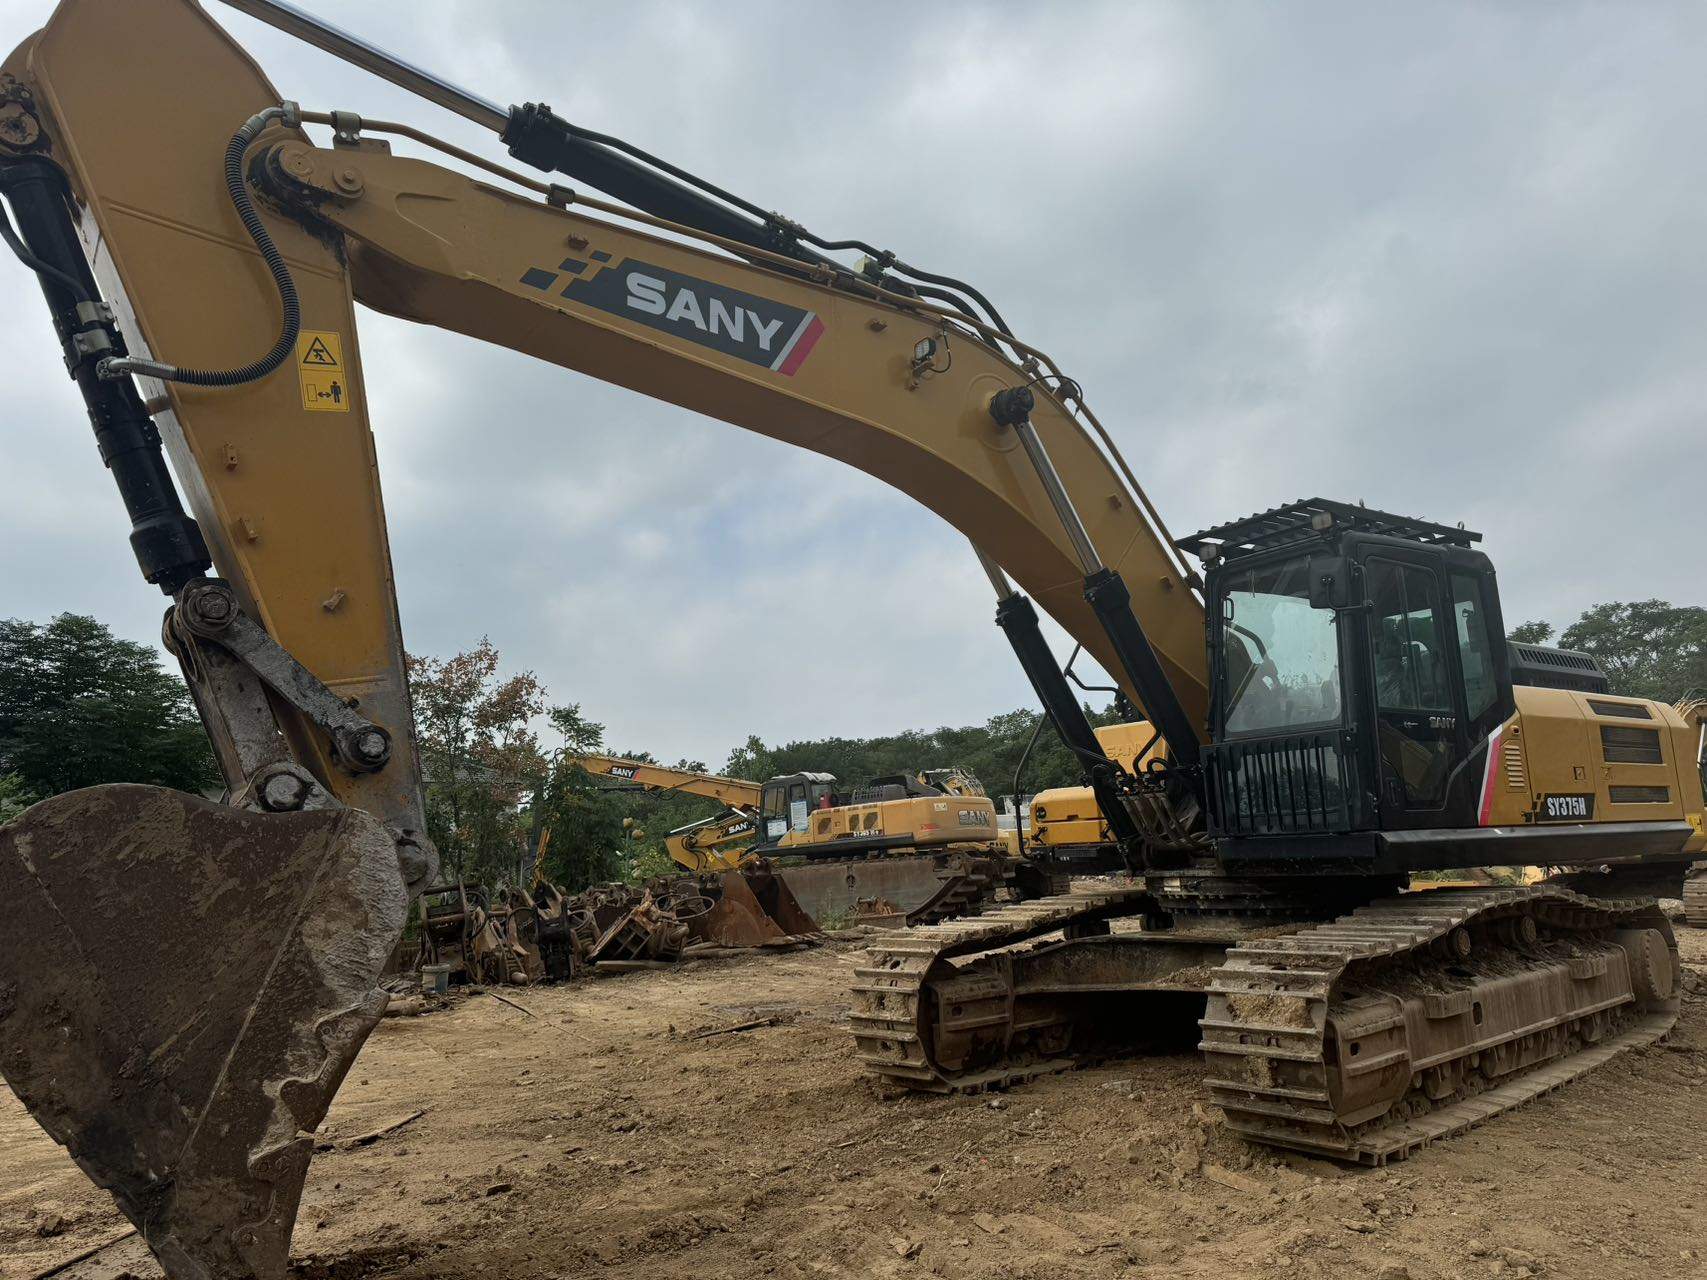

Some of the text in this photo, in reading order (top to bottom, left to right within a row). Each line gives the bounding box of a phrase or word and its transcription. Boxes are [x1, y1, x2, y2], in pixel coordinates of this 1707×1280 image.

[626, 272, 783, 351] SANY
[612, 767, 634, 778] SANY
[1547, 797, 1586, 816] SY375H
[958, 809, 991, 826] SANY
